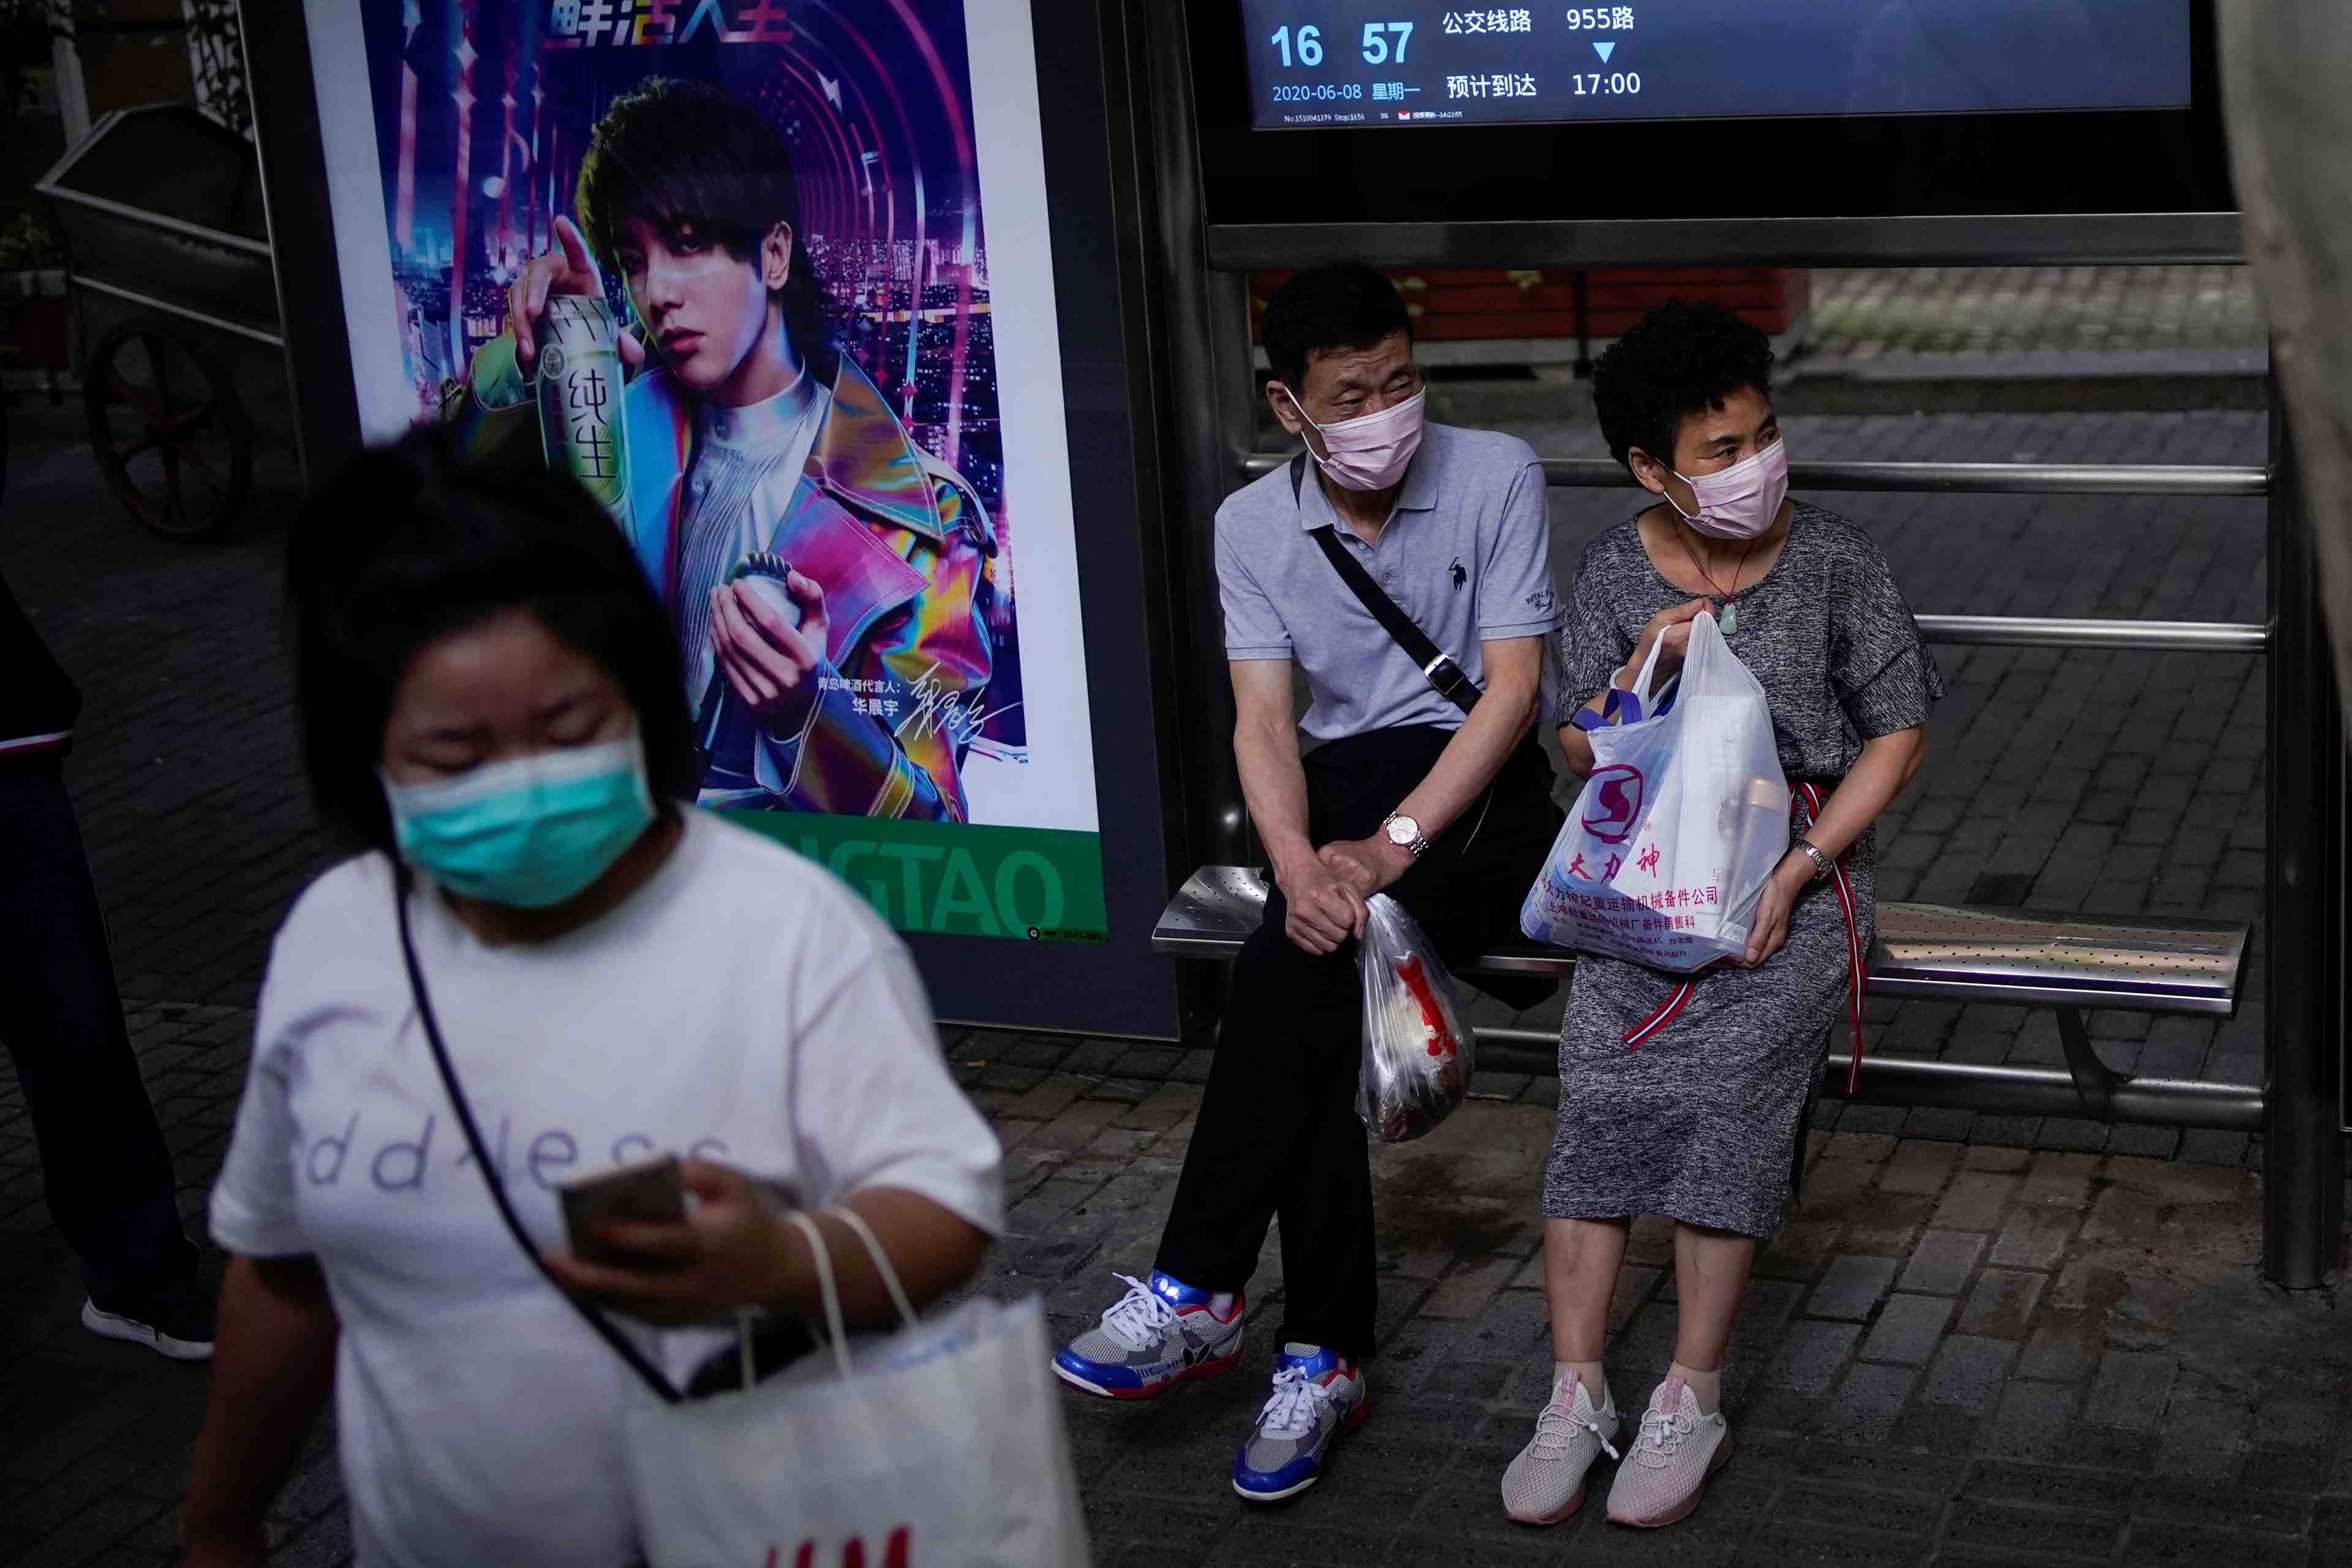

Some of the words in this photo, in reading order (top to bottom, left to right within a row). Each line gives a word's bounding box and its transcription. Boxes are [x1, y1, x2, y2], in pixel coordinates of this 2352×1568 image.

[1442, 10, 1532, 33] 公交线路
[1567, 6, 1634, 30] 955路
[1271, 24, 1323, 67] 16
[1362, 21, 1414, 64] 57
[1273, 85, 1362, 102] 2020-06-08
[1372, 82, 1420, 101] 星期一
[1447, 74, 1536, 98] 预计到达
[1572, 72, 1641, 96] 17:00
[567, 369, 617, 478] 纯生
[852, 697, 899, 717] 华晨宇
[1570, 843, 1660, 884] 大力神
[800, 837, 1065, 939] GTAO
